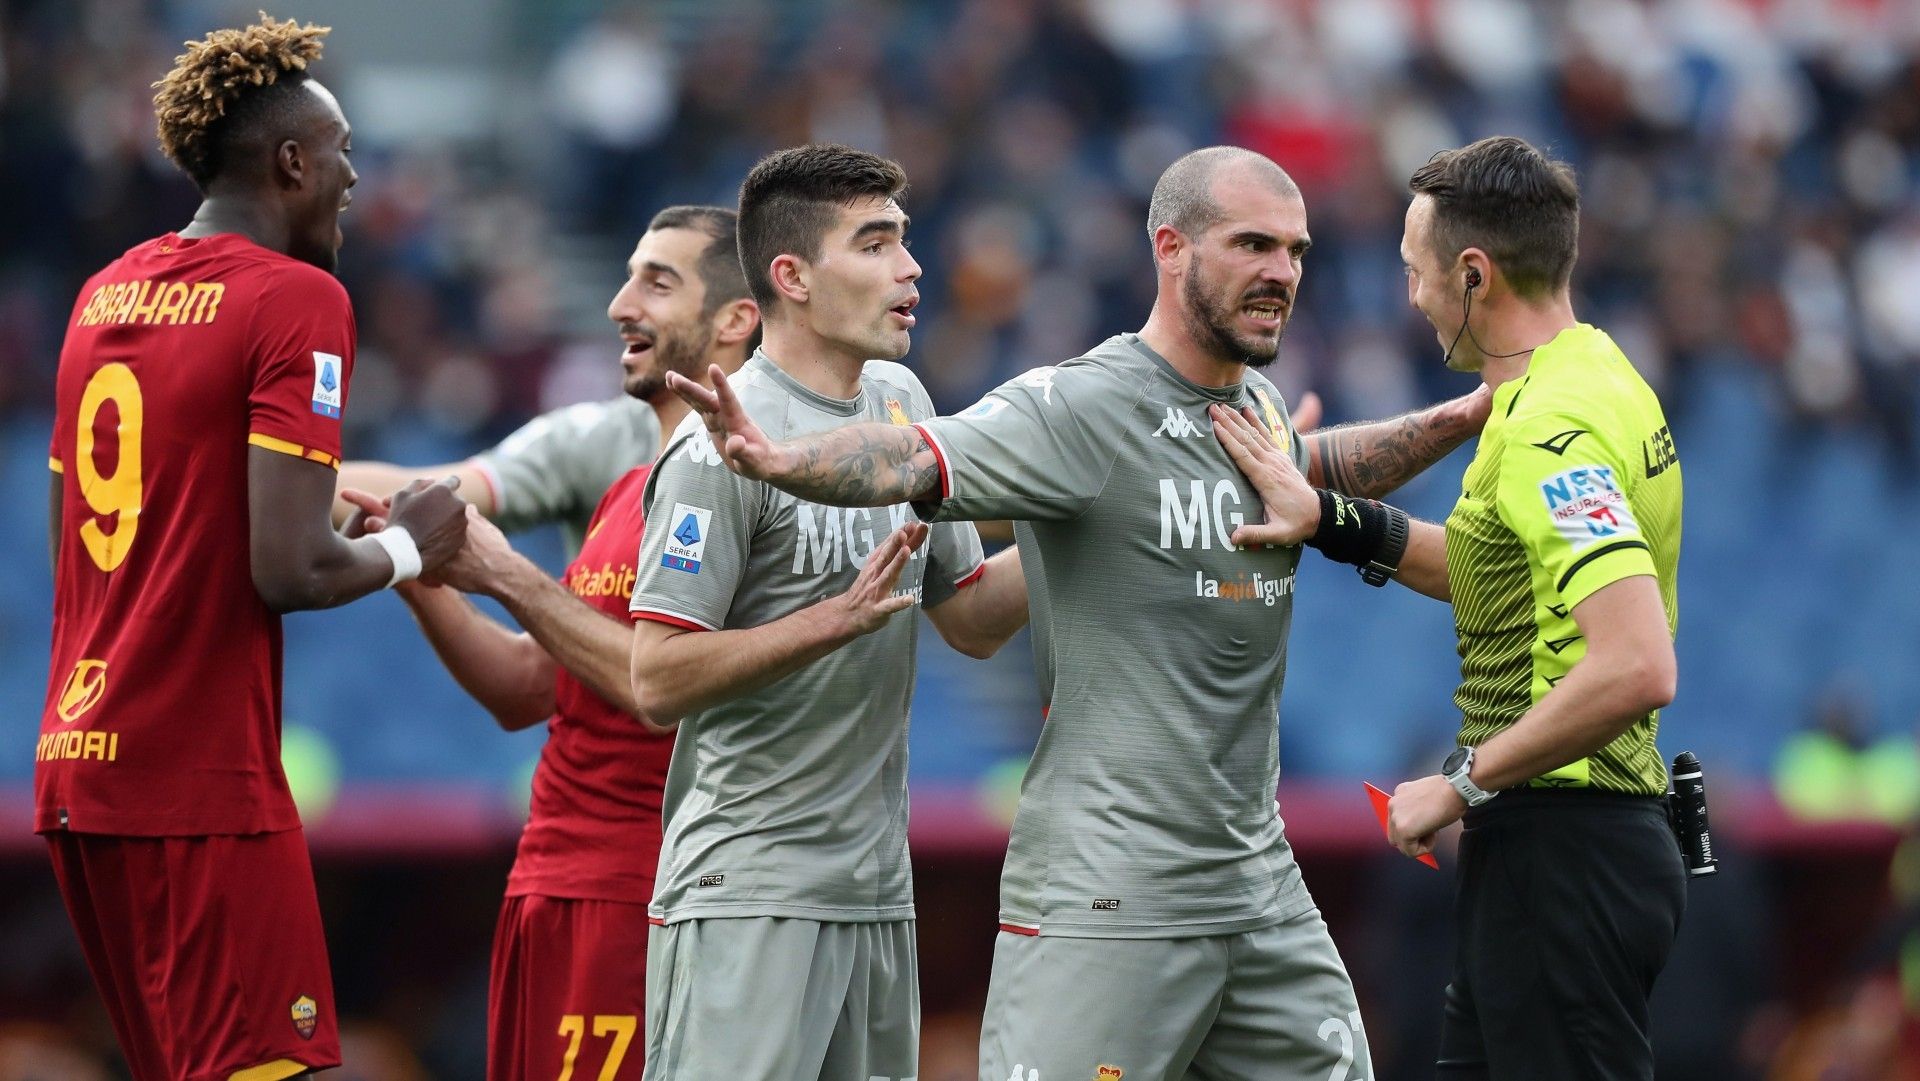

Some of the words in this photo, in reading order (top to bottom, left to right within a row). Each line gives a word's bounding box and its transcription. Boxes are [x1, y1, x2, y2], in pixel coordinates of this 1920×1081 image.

[76, 280, 225, 327] ABRAHAM
[76, 362, 143, 572] 9
[1643, 425, 1678, 479] LEGE
[1554, 492, 1622, 521] INSURANCE
[669, 547, 691, 557] SERIE
[558, 1014, 637, 1081] 77
